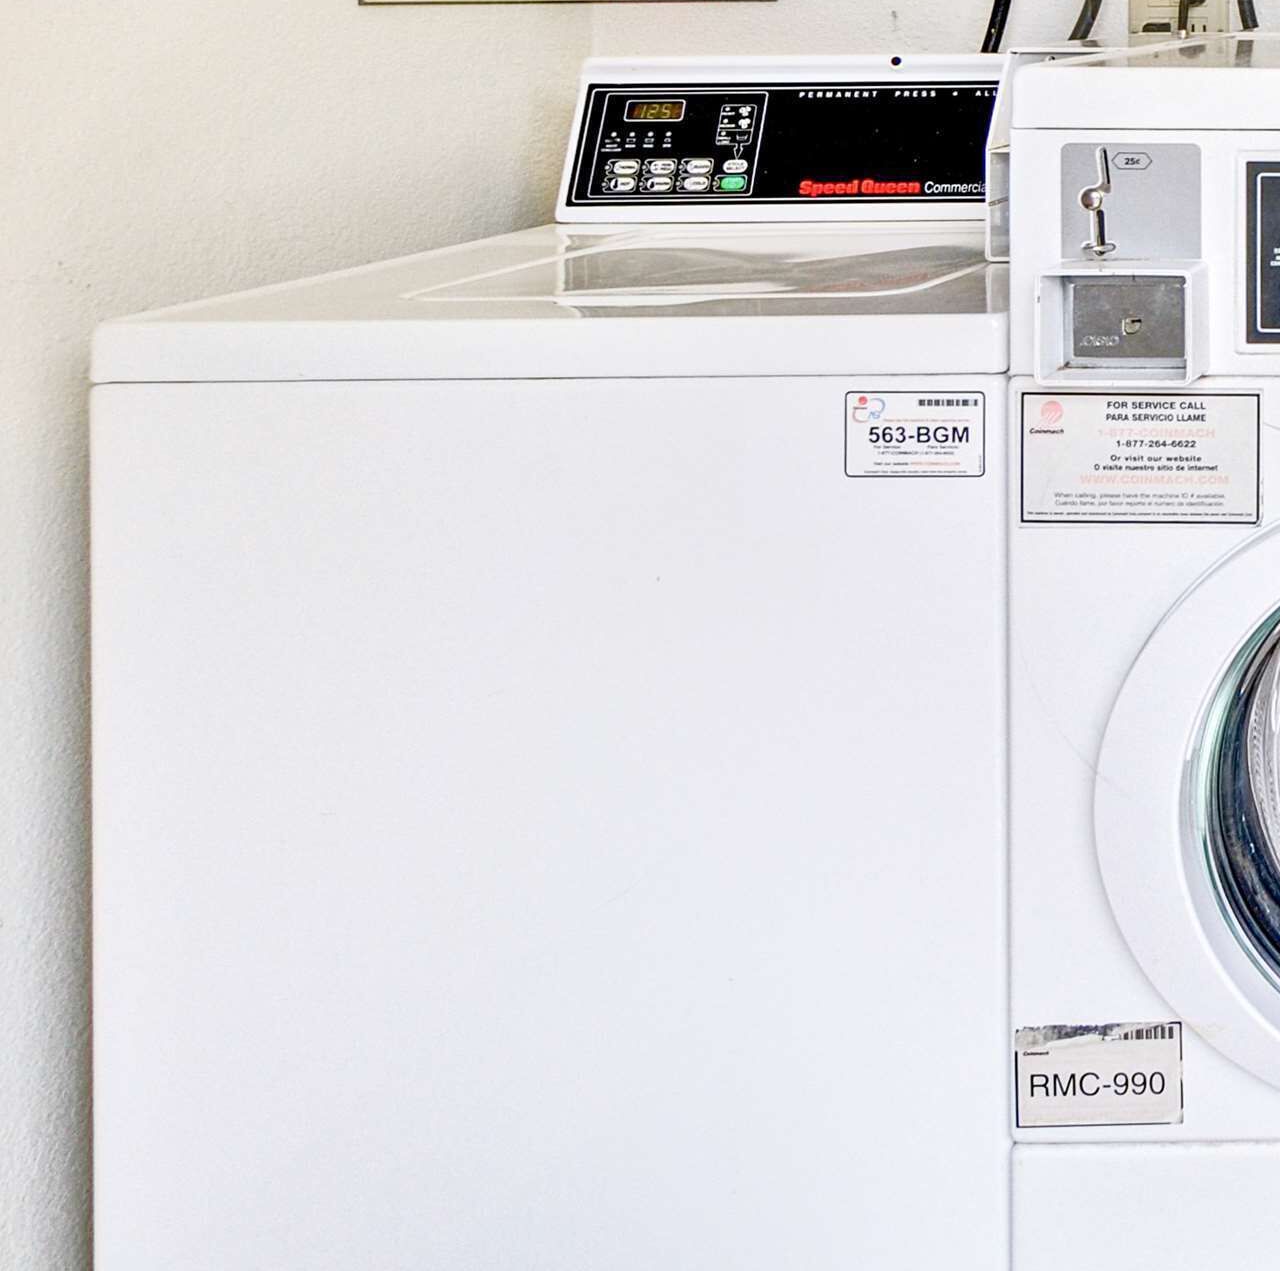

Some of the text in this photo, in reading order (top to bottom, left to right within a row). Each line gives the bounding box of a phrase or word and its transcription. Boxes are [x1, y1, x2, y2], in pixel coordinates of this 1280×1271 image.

[895, 90, 937, 98] PRESS
[799, 180, 859, 197] Speed
[861, 179, 920, 194] Queen
[1107, 401, 1206, 410] FOR SERVICE CALL
[1106, 414, 1206, 422] PARA SERVICIO LLAME
[869, 426, 969, 443] 563-BGM
[1098, 429, 1216, 438] 1-877-COINMACH
[1116, 440, 1196, 448] 1-877-264-6622
[1157, 464, 1174, 472] sitio
[1176, 464, 1185, 472] de
[1187, 464, 1218, 472] internet
[1080, 475, 1229, 485] WWW.COINMACH.COM
[1030, 1072, 1165, 1097] RMC-990
